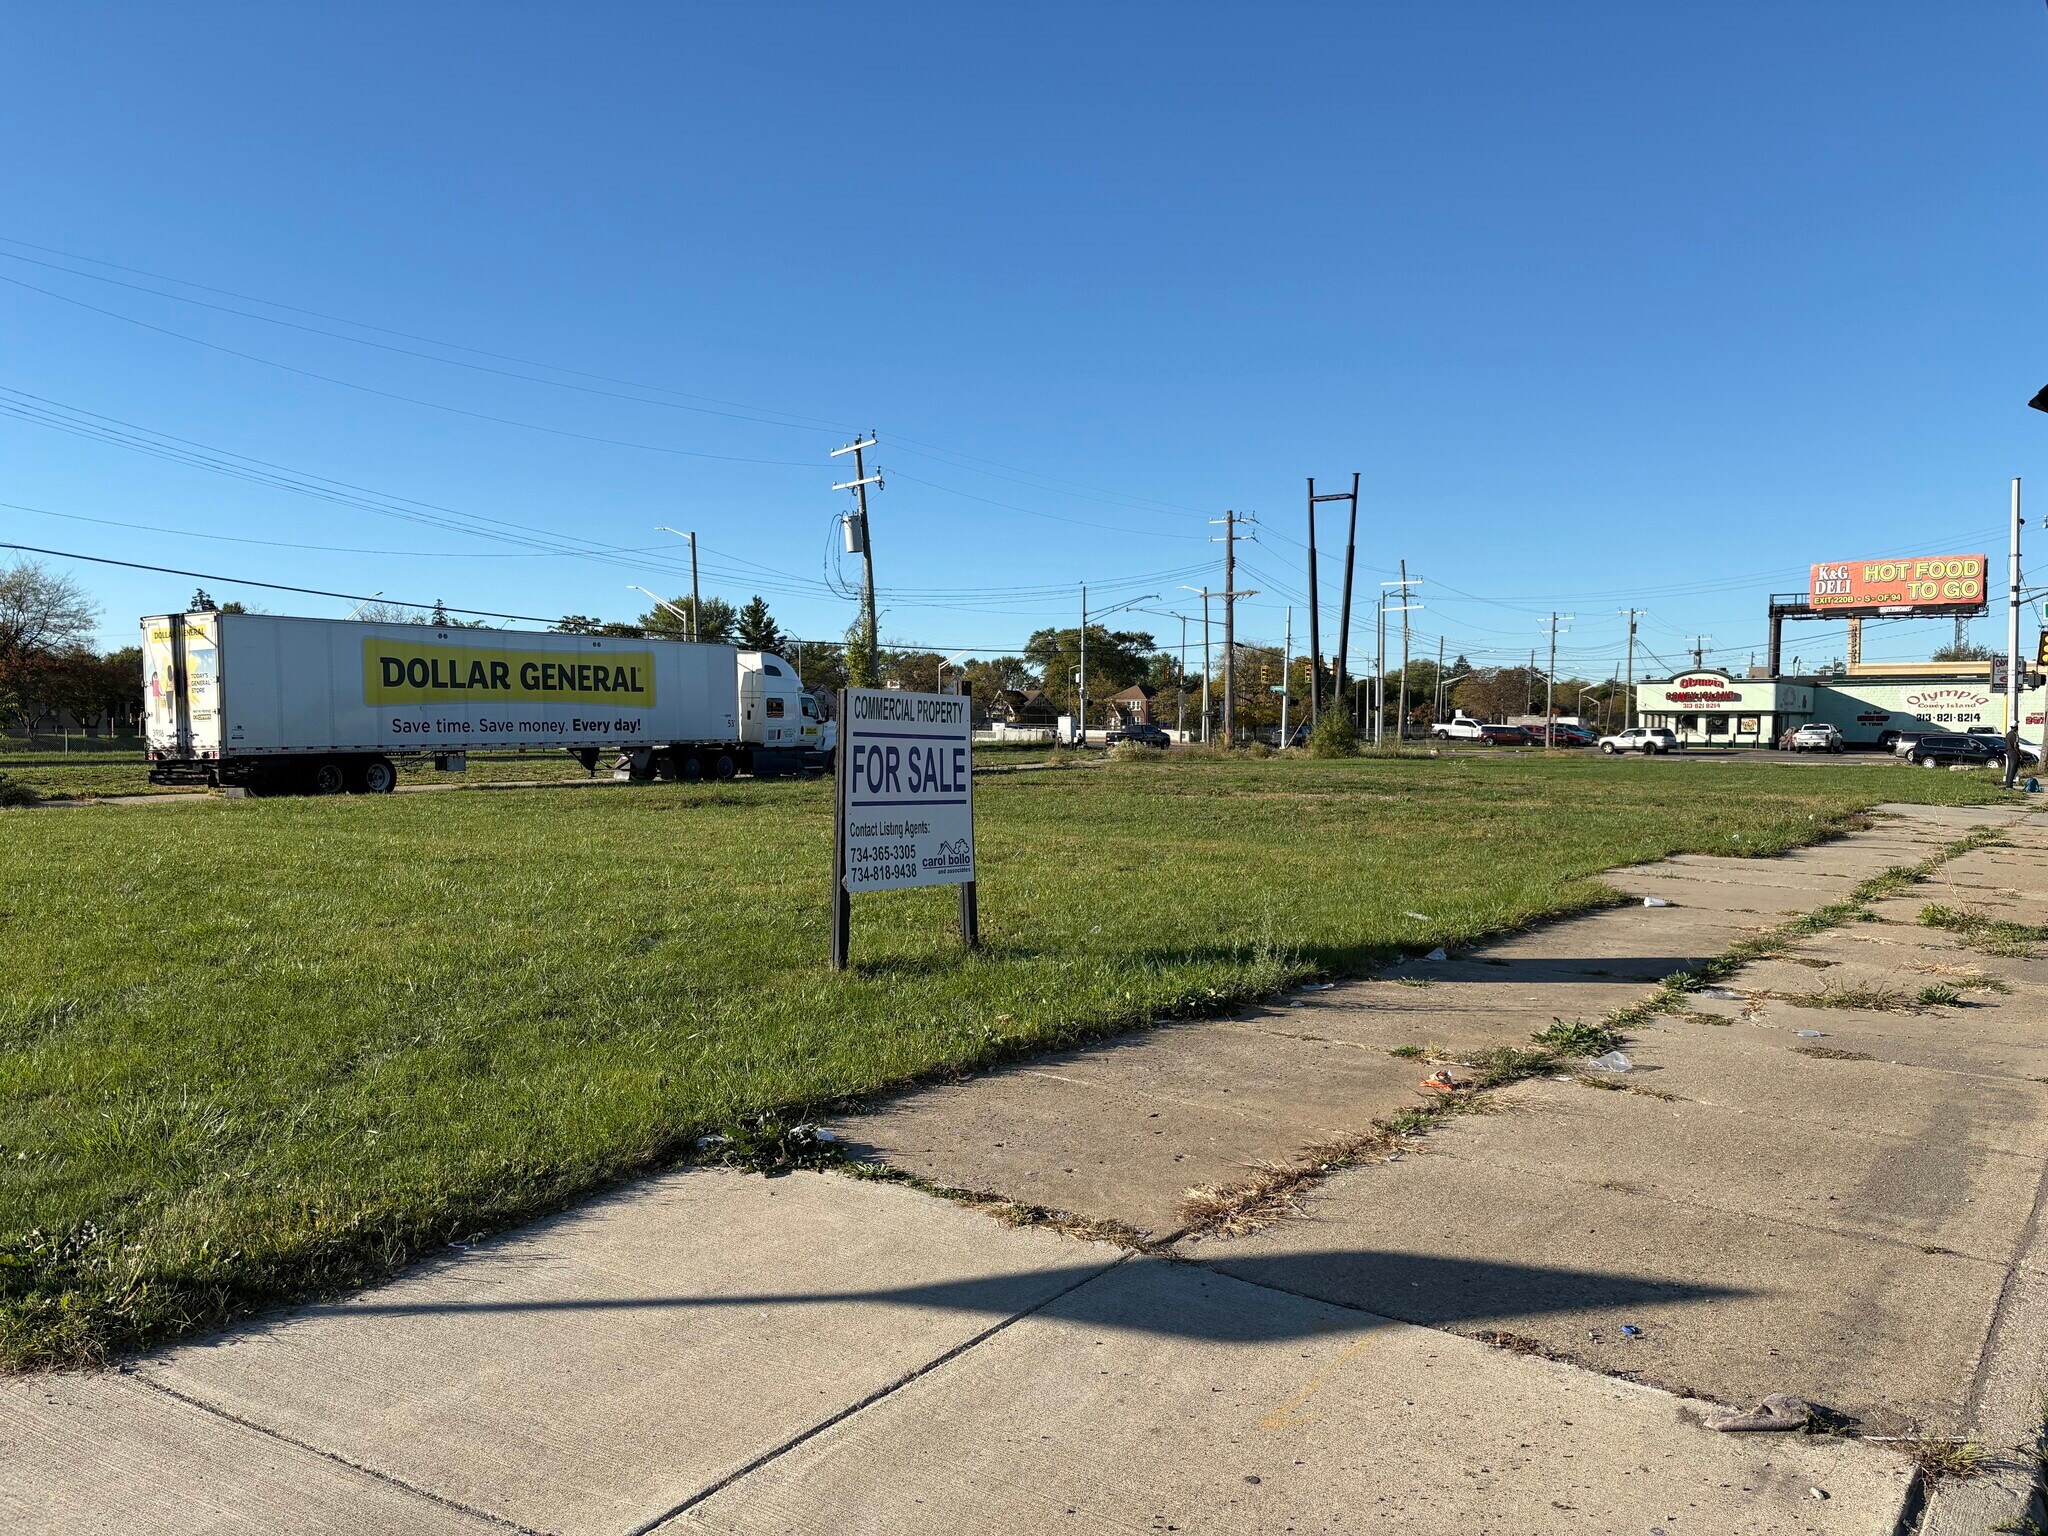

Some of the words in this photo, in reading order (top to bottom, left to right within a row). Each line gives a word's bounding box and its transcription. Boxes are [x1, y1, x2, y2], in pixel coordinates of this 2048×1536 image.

[1818, 566, 1849, 581] K&G
[1863, 563, 1911, 583] HOT
[1914, 559, 1981, 581] FOOD
[1814, 579, 1851, 595] DELI
[1906, 581, 1939, 600] TO
[1942, 578, 1981, 599] GO
[1813, 597, 1832, 605] EXIT
[380, 657, 511, 690] DOLLAR
[520, 662, 644, 692] GENERAL
[1680, 678, 1724, 689] Olympia
[1665, 692, 1697, 702] CONEY
[1699, 691, 1735, 702] ISLAND
[1907, 690, 1989, 705] Olympia
[854, 695, 915, 722] COMMERCIAL
[917, 699, 964, 724] PROPERTY
[392, 718, 431, 733] Save
[435, 718, 475, 733] time.
[479, 718, 514, 732] Save
[518, 719, 569, 735] money.
[572, 718, 610, 735] Every
[613, 718, 642, 733] day!
[852, 744, 901, 794] FOR
[908, 746, 966, 794] SALE
[849, 822, 879, 838] Contact
[879, 821, 904, 839] Listing
[904, 820, 931, 838] Agents:
[850, 844, 917, 863] 734-365-3305
[922, 854, 946, 868] carol
[948, 853, 971, 866] bollo
[851, 863, 917, 883] 734-818-9438
